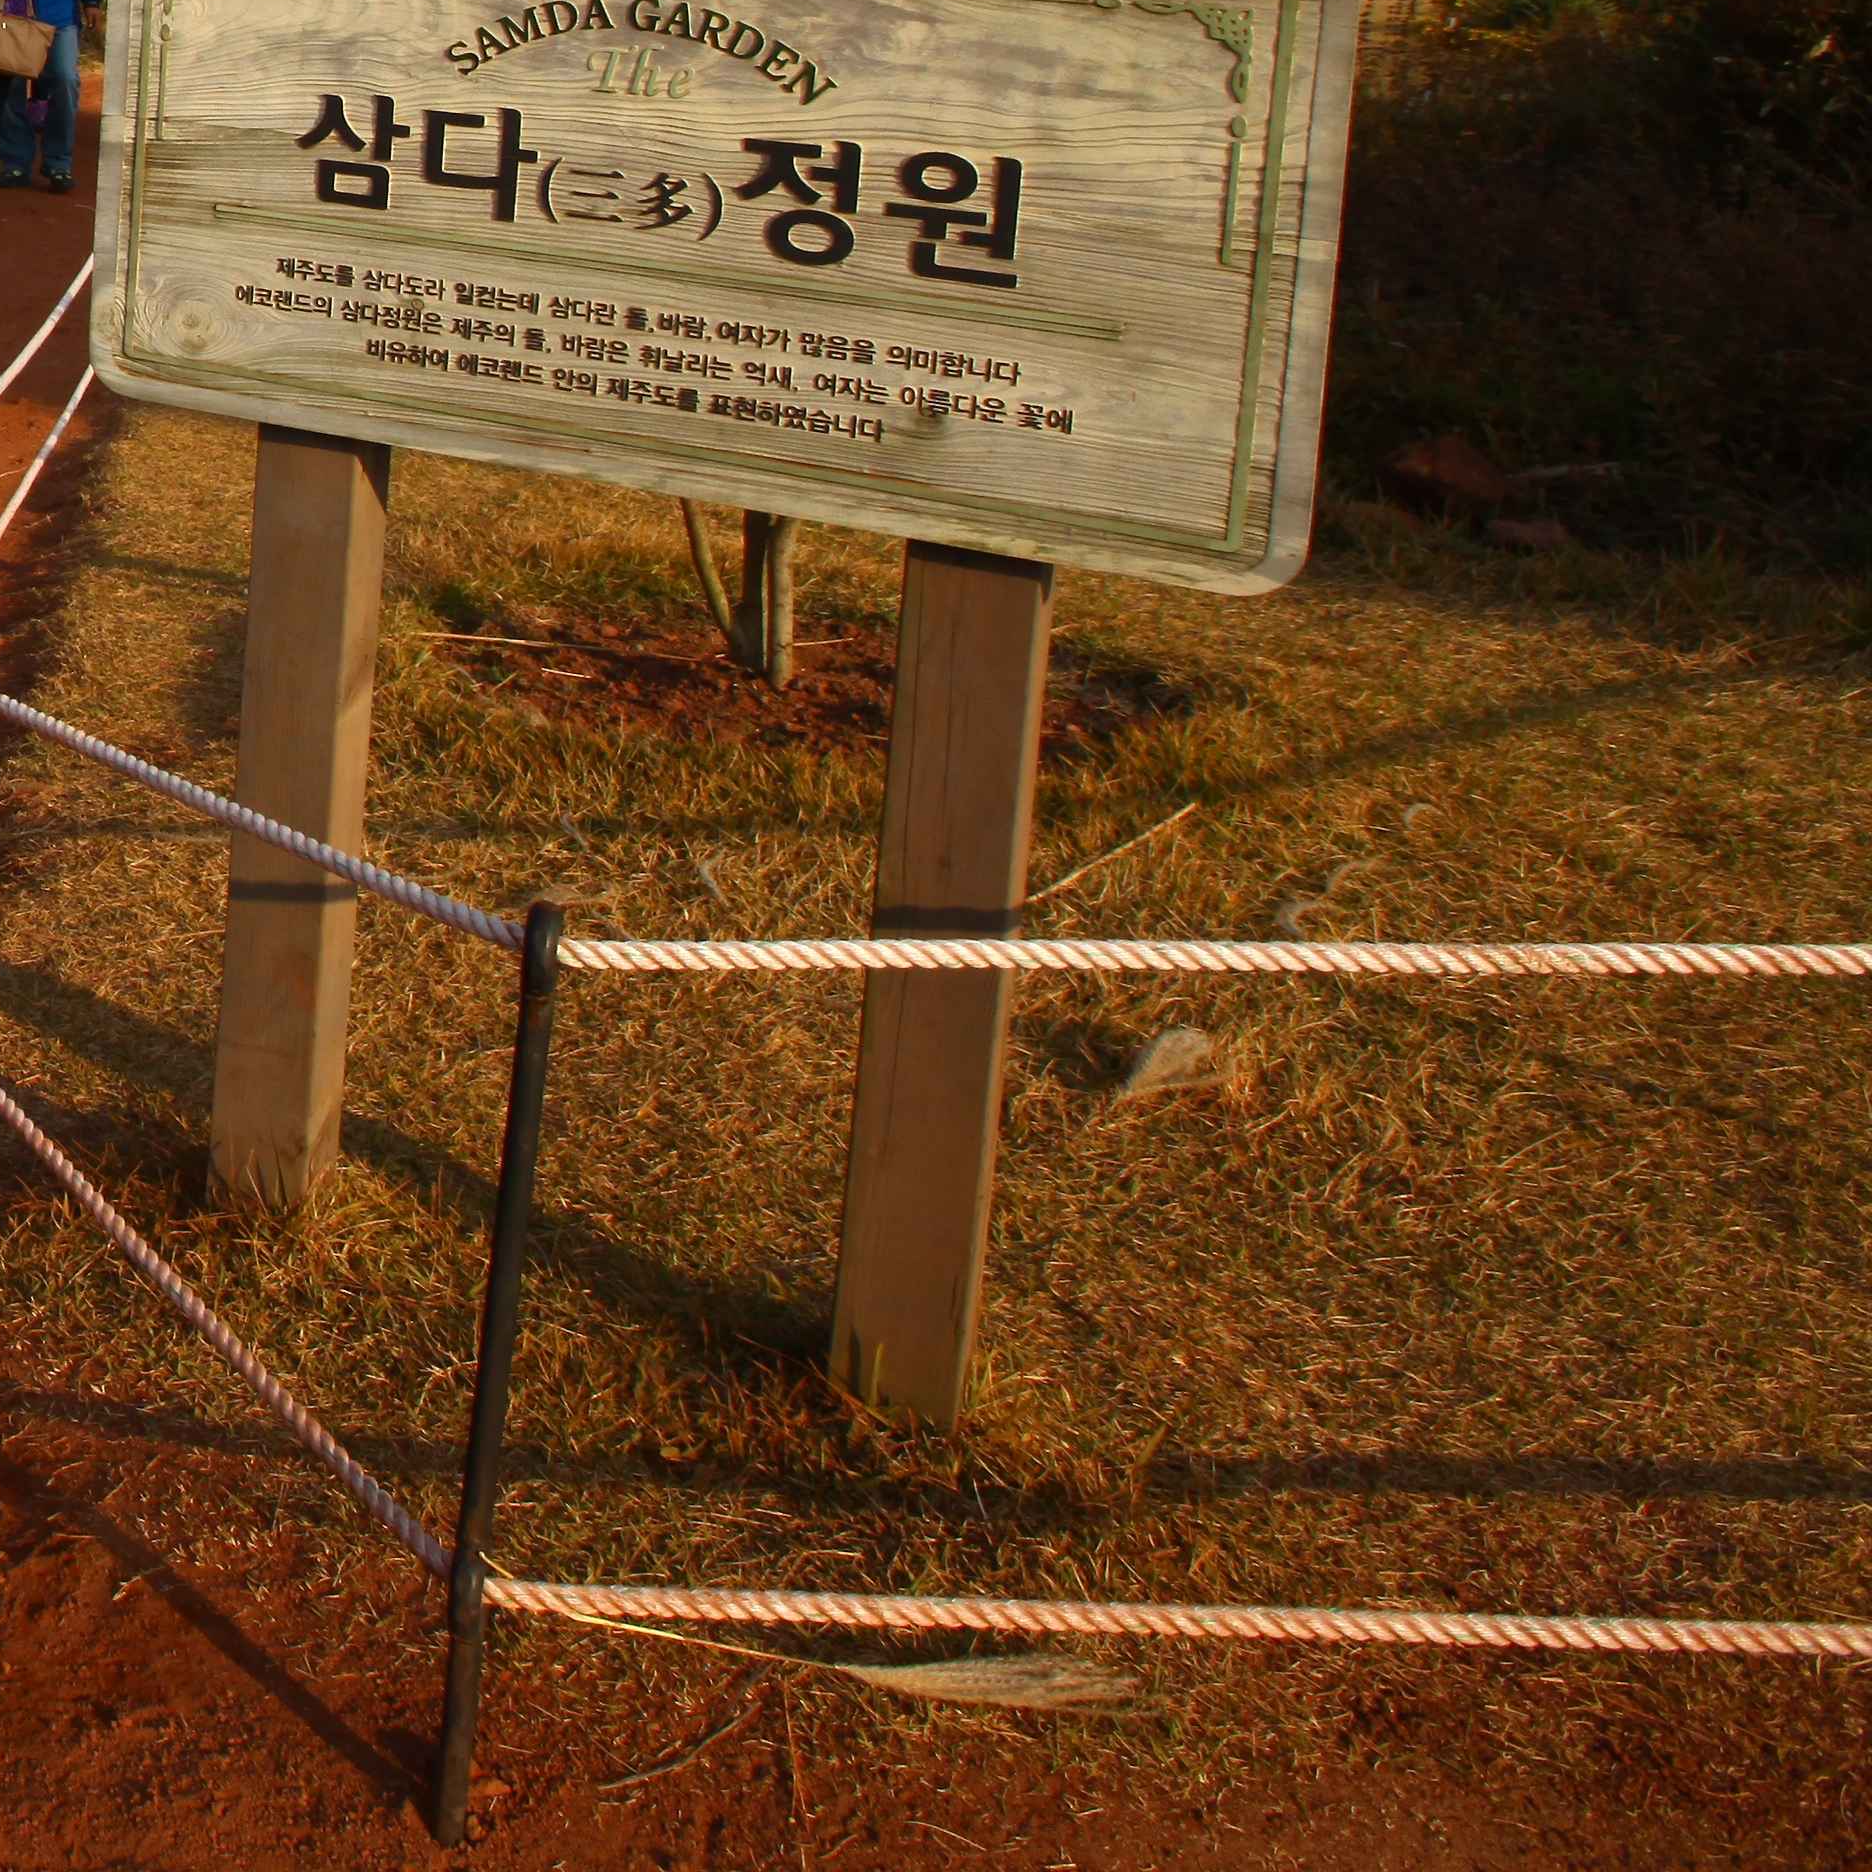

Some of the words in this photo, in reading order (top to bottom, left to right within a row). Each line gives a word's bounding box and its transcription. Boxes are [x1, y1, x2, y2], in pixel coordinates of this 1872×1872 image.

[586, 42, 696, 100] The
[235, 284, 333, 317] 에코랜드의
[340, 299, 443, 336] 삼다정원은
[451, 316, 516, 347] 제주의
[560, 334, 630, 365] 바람은
[638, 344, 733, 381] 휘날리는
[812, 373, 888, 405] 여자는
[899, 385, 1008, 425] 아름다운
[1017, 401, 1074, 435] 꽃에
[276, 257, 355, 287] 제주도를
[362, 269, 446, 301] 삼다도라
[547, 296, 617, 328] 삼다란
[715, 320, 791, 353] 여자가
[798, 331, 877, 365] 많음을
[884, 345, 1022, 386] 의미합니다
[366, 338, 449, 372] 비유하여
[456, 353, 545, 384] 에코랜드
[552, 367, 597, 397] 안의
[607, 377, 700, 413] 제주도를
[708, 393, 886, 443] 표현하였습니다
